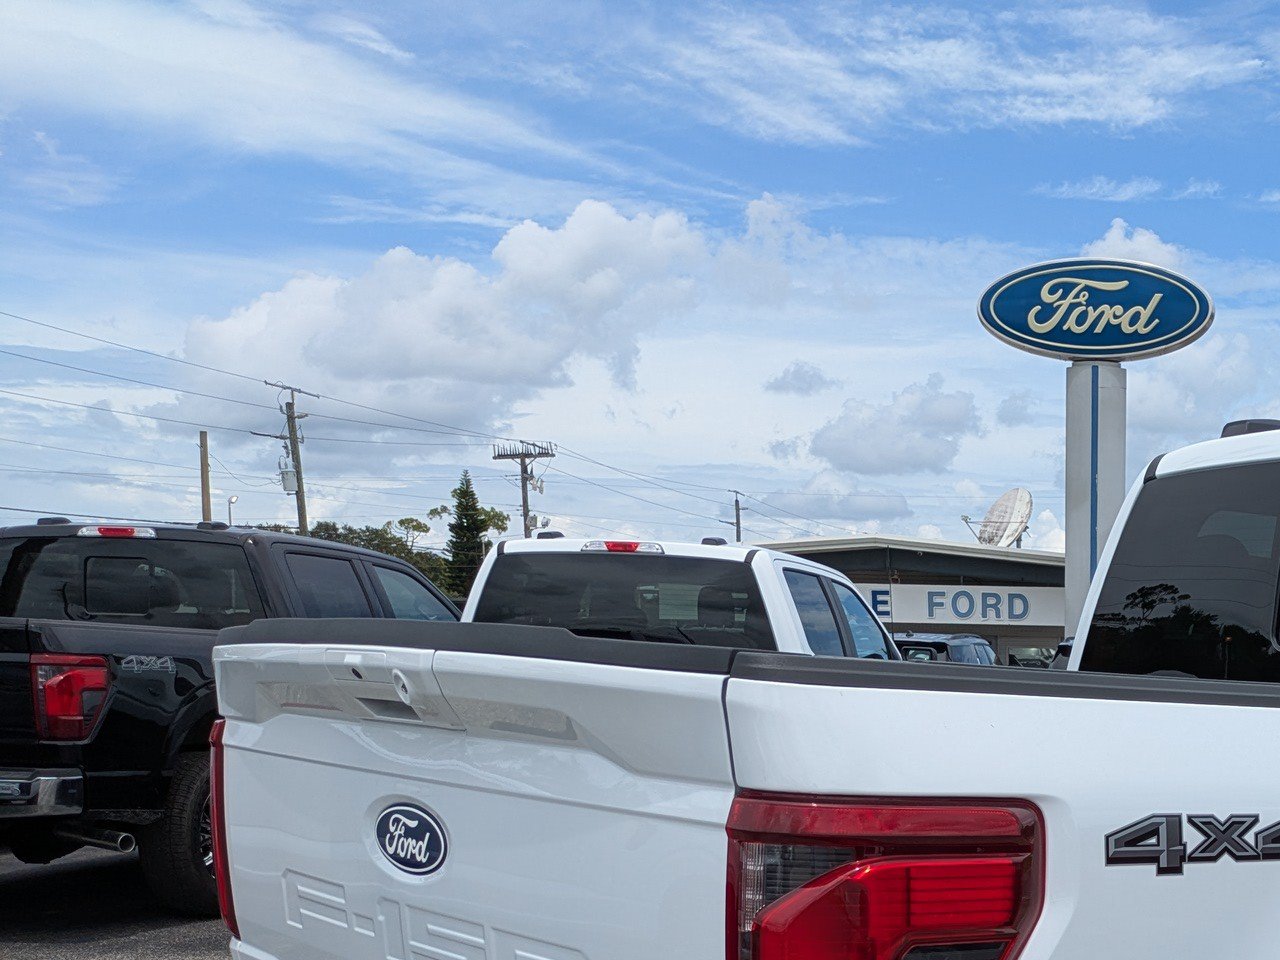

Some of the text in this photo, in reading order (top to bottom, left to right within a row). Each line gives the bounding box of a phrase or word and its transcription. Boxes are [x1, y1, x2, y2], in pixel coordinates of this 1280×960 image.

[1027, 277, 1163, 335] Ford
[927, 591, 1030, 620] FORD
[385, 813, 430, 863] Ford
